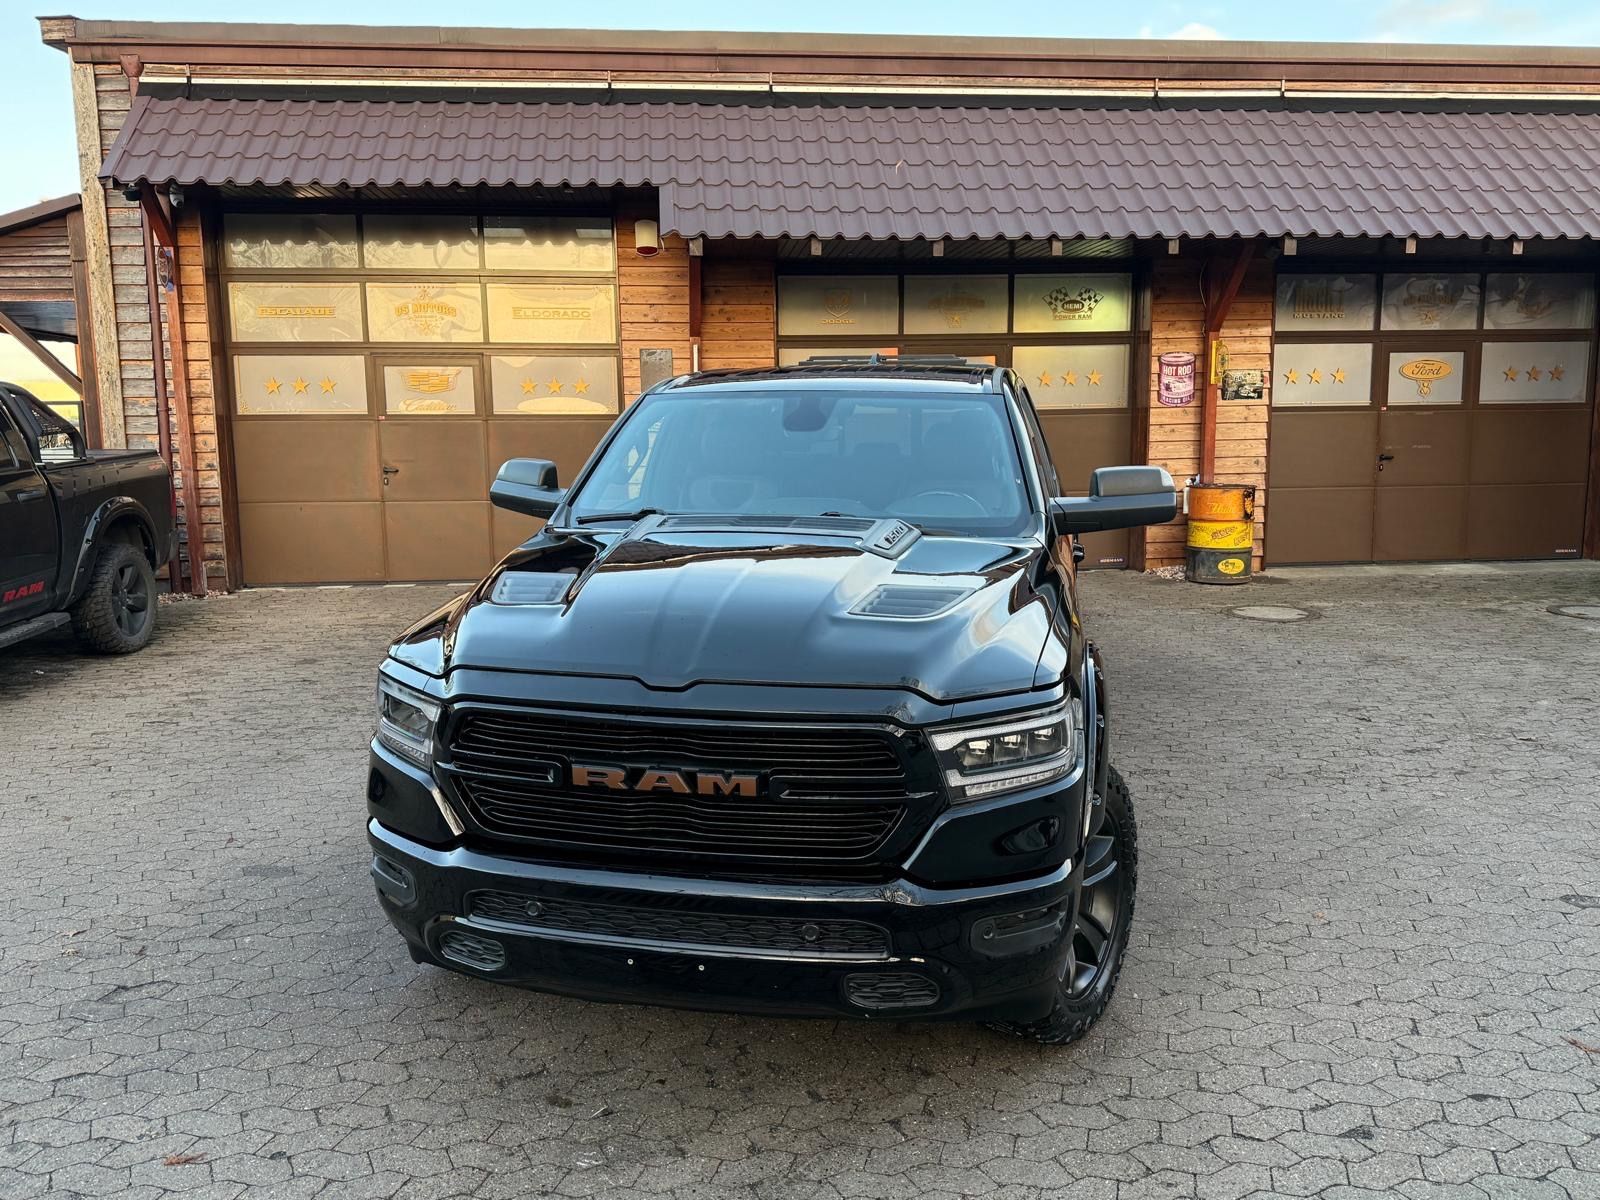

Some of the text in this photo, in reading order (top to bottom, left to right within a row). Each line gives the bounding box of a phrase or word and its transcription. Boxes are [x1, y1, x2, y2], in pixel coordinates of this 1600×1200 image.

[512, 309, 592, 318] ELDORADO
[1163, 365, 1192, 376] HOT ROD
[1411, 362, 1442, 376] Ford
[3, 580, 46, 602] RAM
[571, 763, 758, 797] RAM
